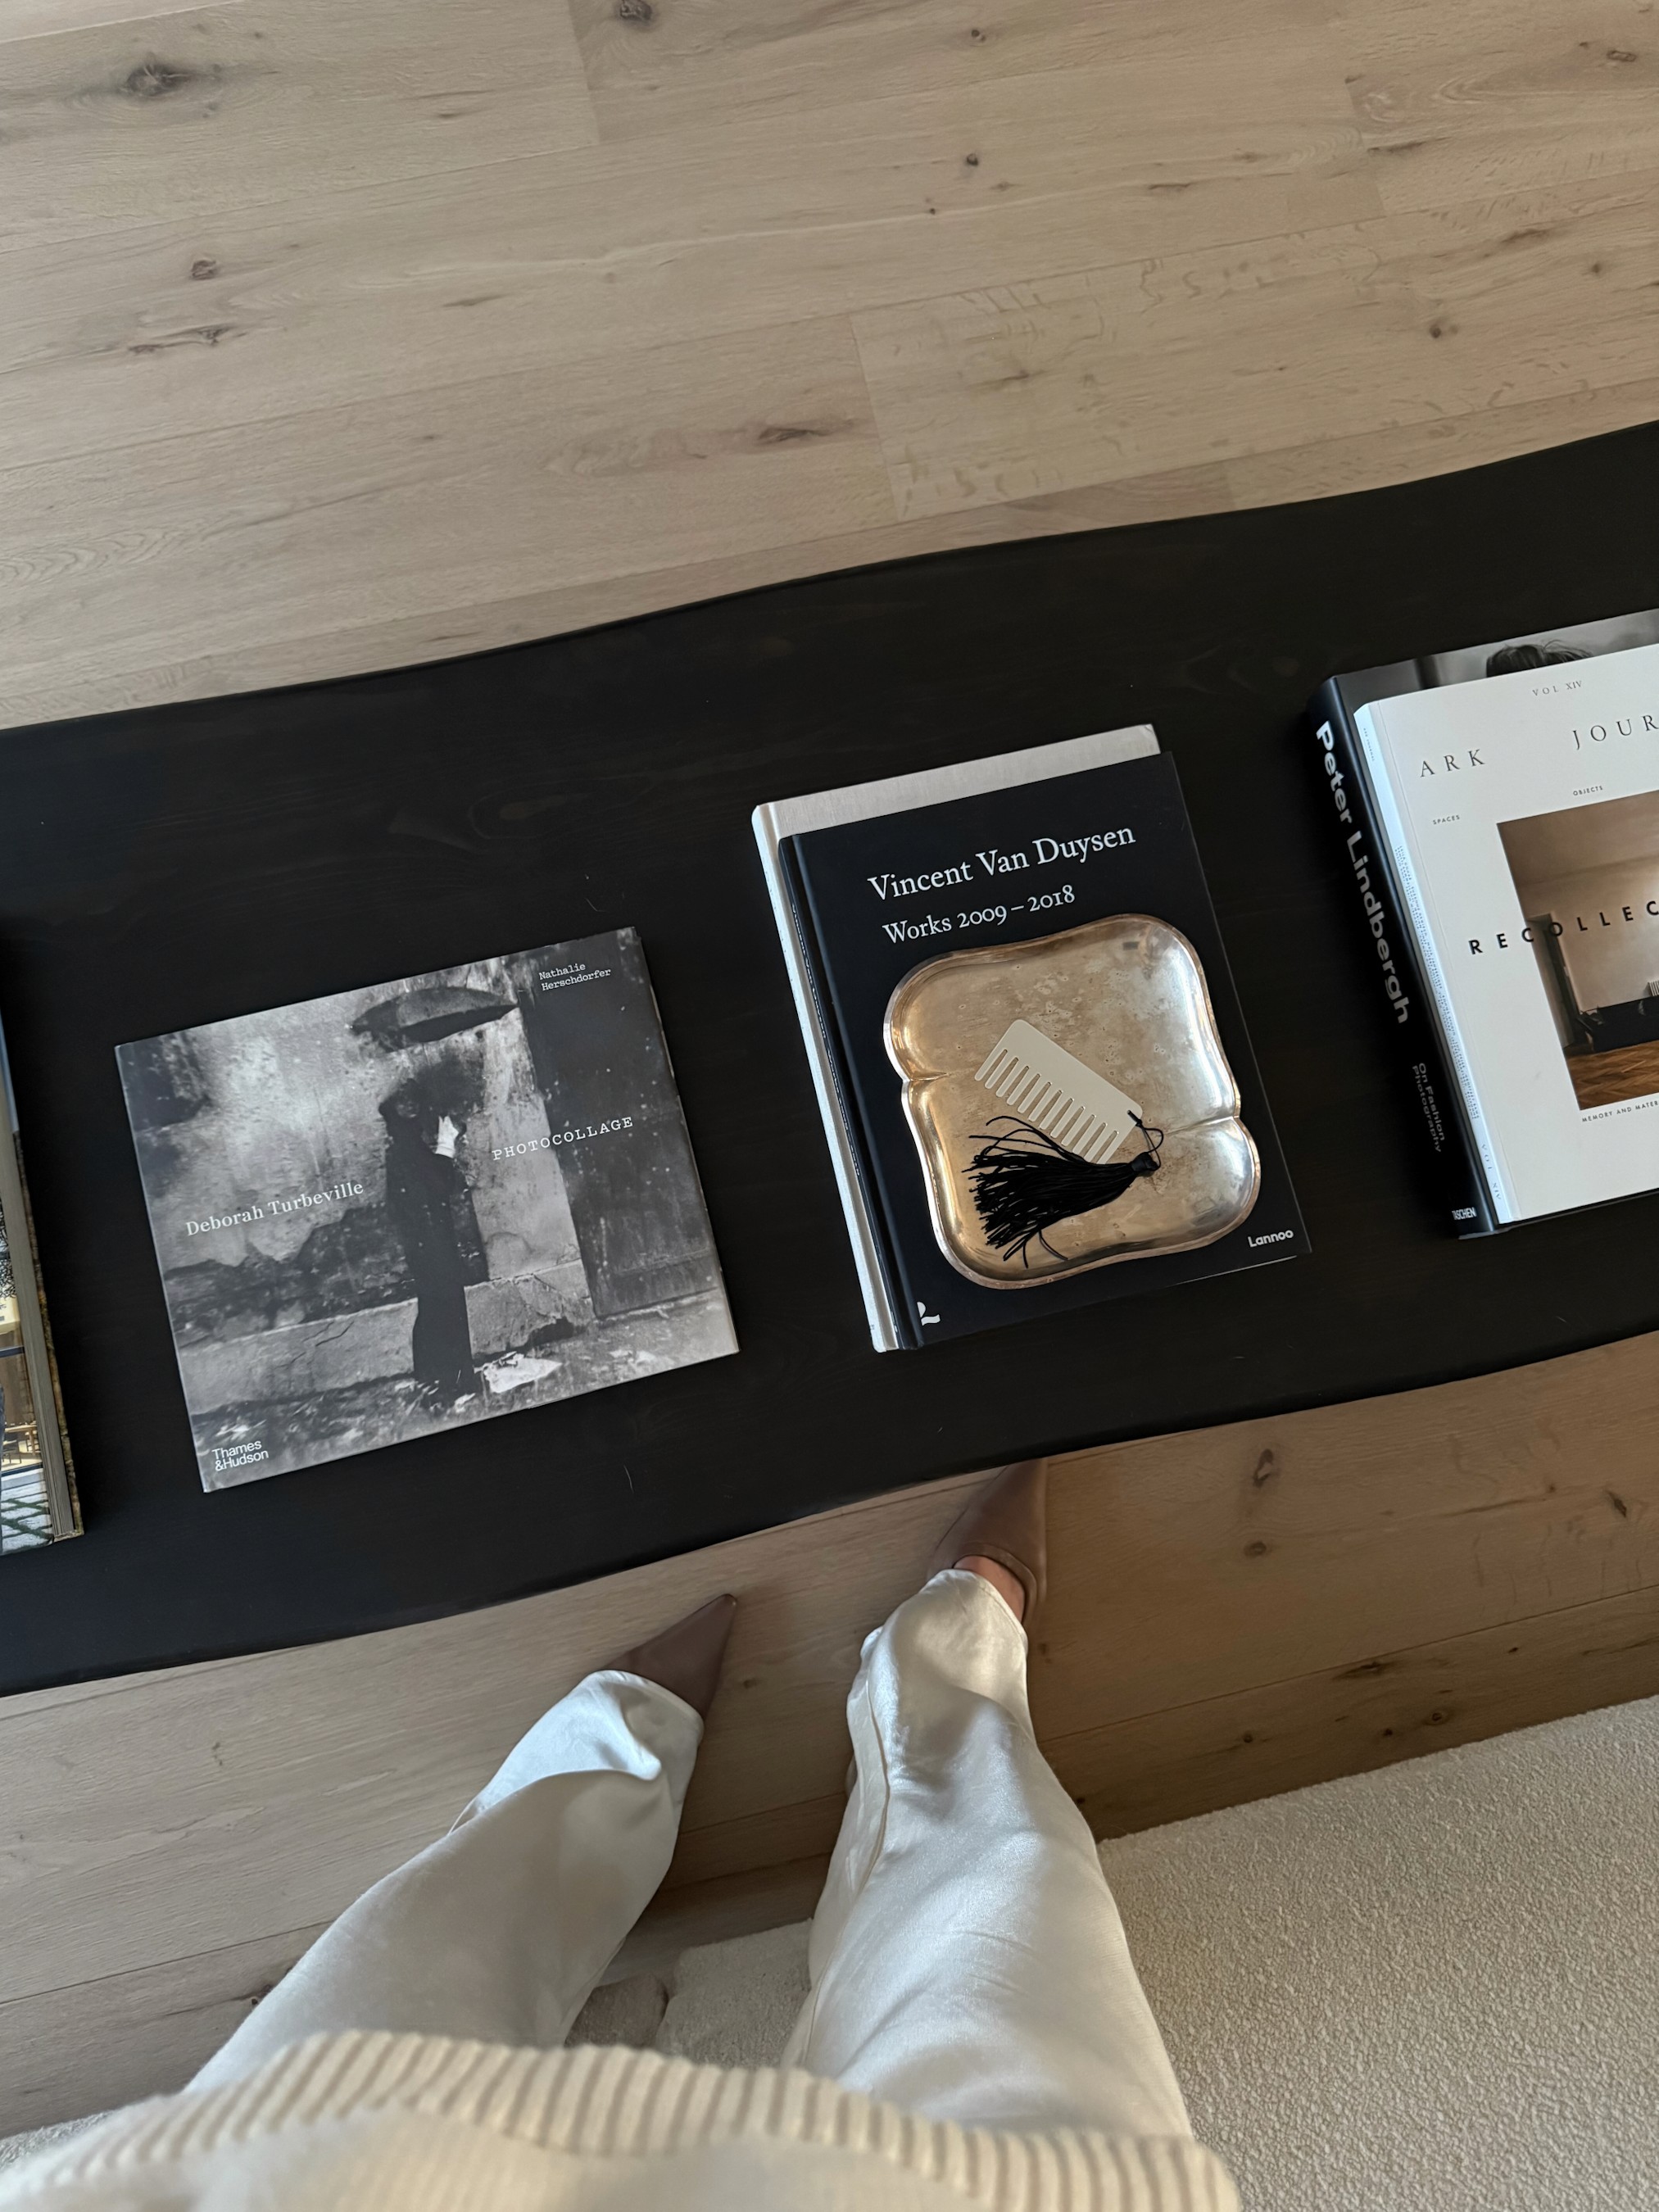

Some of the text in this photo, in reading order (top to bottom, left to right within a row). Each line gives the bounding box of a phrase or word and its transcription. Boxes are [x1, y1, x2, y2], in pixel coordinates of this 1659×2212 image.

[1532, 680, 1583, 696] VOL XIV
[1420, 714, 1659, 777] ARK JOUR
[1572, 785, 1603, 796] OBJECTS
[1432, 814, 1460, 825] SPACES
[867, 827, 1135, 900] Vincent Van Duysen
[1316, 720, 1409, 1024] Peter Lindbergh
[882, 914, 952, 944] Works
[956, 905, 1007, 929] 2009
[1027, 884, 1076, 913] 2018
[1468, 900, 1659, 955] RECOLLEC
[538, 963, 587, 981] Nathalie
[541, 968, 612, 991] Herschdorfer
[1418, 1063, 1445, 1141] On Fashion
[1582, 1111, 1613, 1122] MEMORY
[1616, 1107, 1632, 1115] AND
[491, 1116, 634, 1161] PHOTOCOLLAGE
[185, 1181, 364, 1236] Deborah Turbeville
[1247, 1230, 1294, 1248] Lannoo
[211, 1440, 262, 1460] Thames
